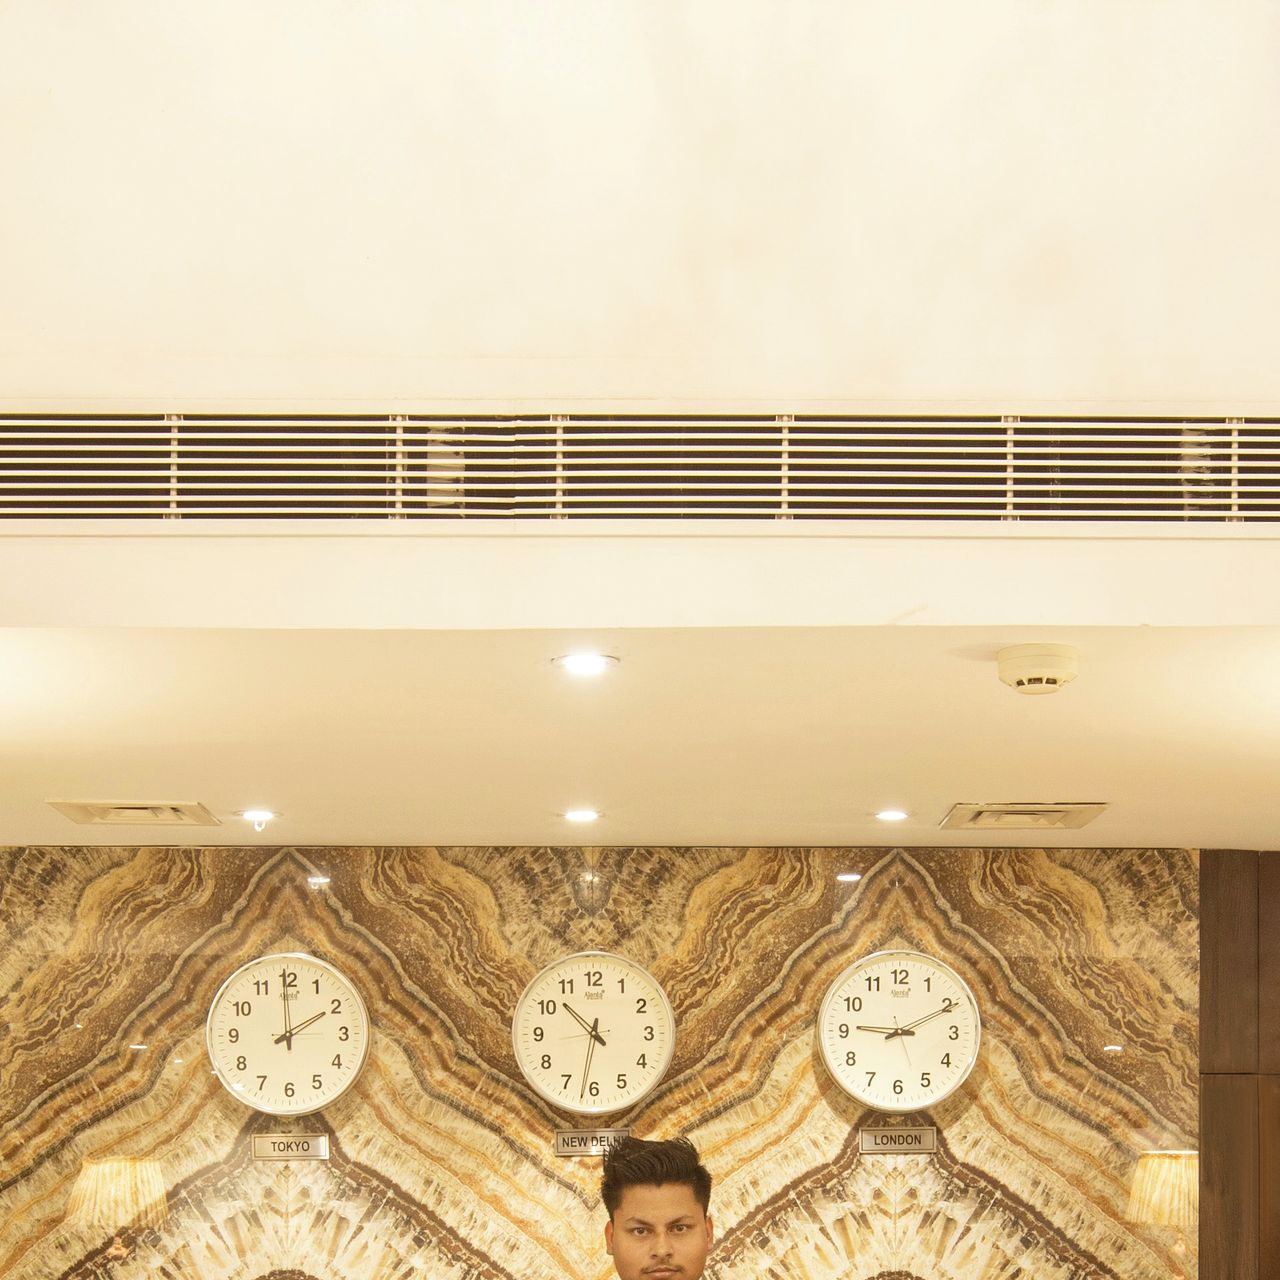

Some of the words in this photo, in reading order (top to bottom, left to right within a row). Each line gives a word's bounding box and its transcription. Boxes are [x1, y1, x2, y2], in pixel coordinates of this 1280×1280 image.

[584, 971, 602, 986] 12
[865, 977, 879, 991] 11
[891, 969, 908, 984] 12
[253, 980, 268, 995] 11
[312, 979, 319, 994] 1
[559, 979, 573, 994] 11
[618, 978, 624, 993] 1
[924, 977, 930, 992] 1
[233, 1001, 251, 1016] 10
[331, 999, 341, 1014] 2
[538, 1000, 556, 1015] 10
[637, 999, 646, 1013] 2
[844, 997, 862, 1012] 10
[942, 998, 953, 1013] 2
[229, 1028, 239, 1043] 9
[339, 1026, 349, 1041] 3
[534, 1027, 543, 1041] 9
[644, 1026, 654, 1041] 3
[839, 1024, 849, 1038] 9
[949, 1026, 959, 1040] 3
[237, 1056, 246, 1070] 8
[332, 1054, 342, 1069] 4
[541, 1055, 551, 1069] 8
[637, 1054, 647, 1068] 4
[846, 1051, 855, 1066] 8
[941, 1053, 951, 1068] 4
[257, 1075, 267, 1090] 7
[312, 1075, 322, 1089] 5
[561, 1075, 572, 1089] 7
[617, 1074, 627, 1089] 5
[866, 1072, 876, 1087] 7
[893, 1080, 903, 1094] 6
[921, 1073, 930, 1087] 5
[285, 1083, 294, 1097] 6
[589, 1082, 599, 1096] 6
[271, 1141, 310, 1153] TOKYO
[562, 1136, 588, 1148] NEW
[874, 1134, 922, 1146] LONDON
